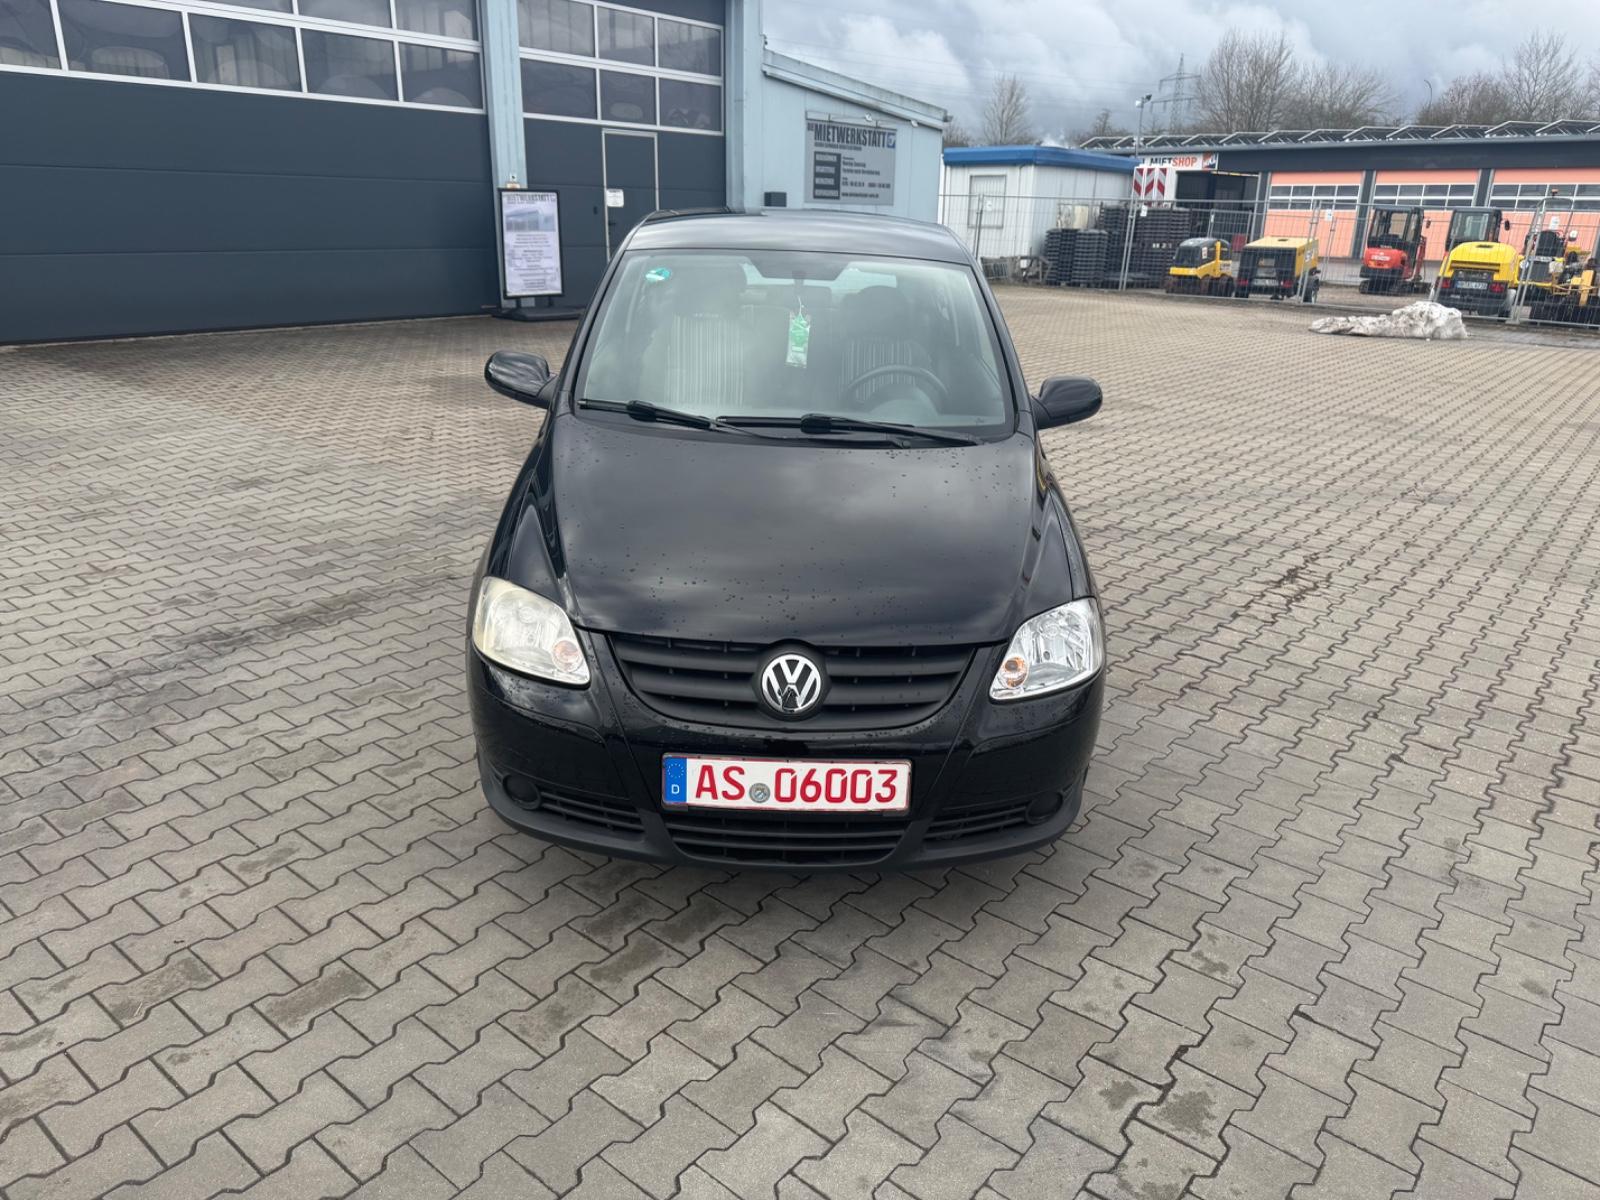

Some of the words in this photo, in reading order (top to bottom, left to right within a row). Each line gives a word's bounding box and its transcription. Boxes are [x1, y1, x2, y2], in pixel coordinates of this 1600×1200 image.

[814, 123, 886, 148] MIETWERKSTATT
[762, 654, 821, 713] VW
[671, 784, 680, 794] D
[695, 765, 745, 800] AS
[774, 768, 898, 803] 06003
